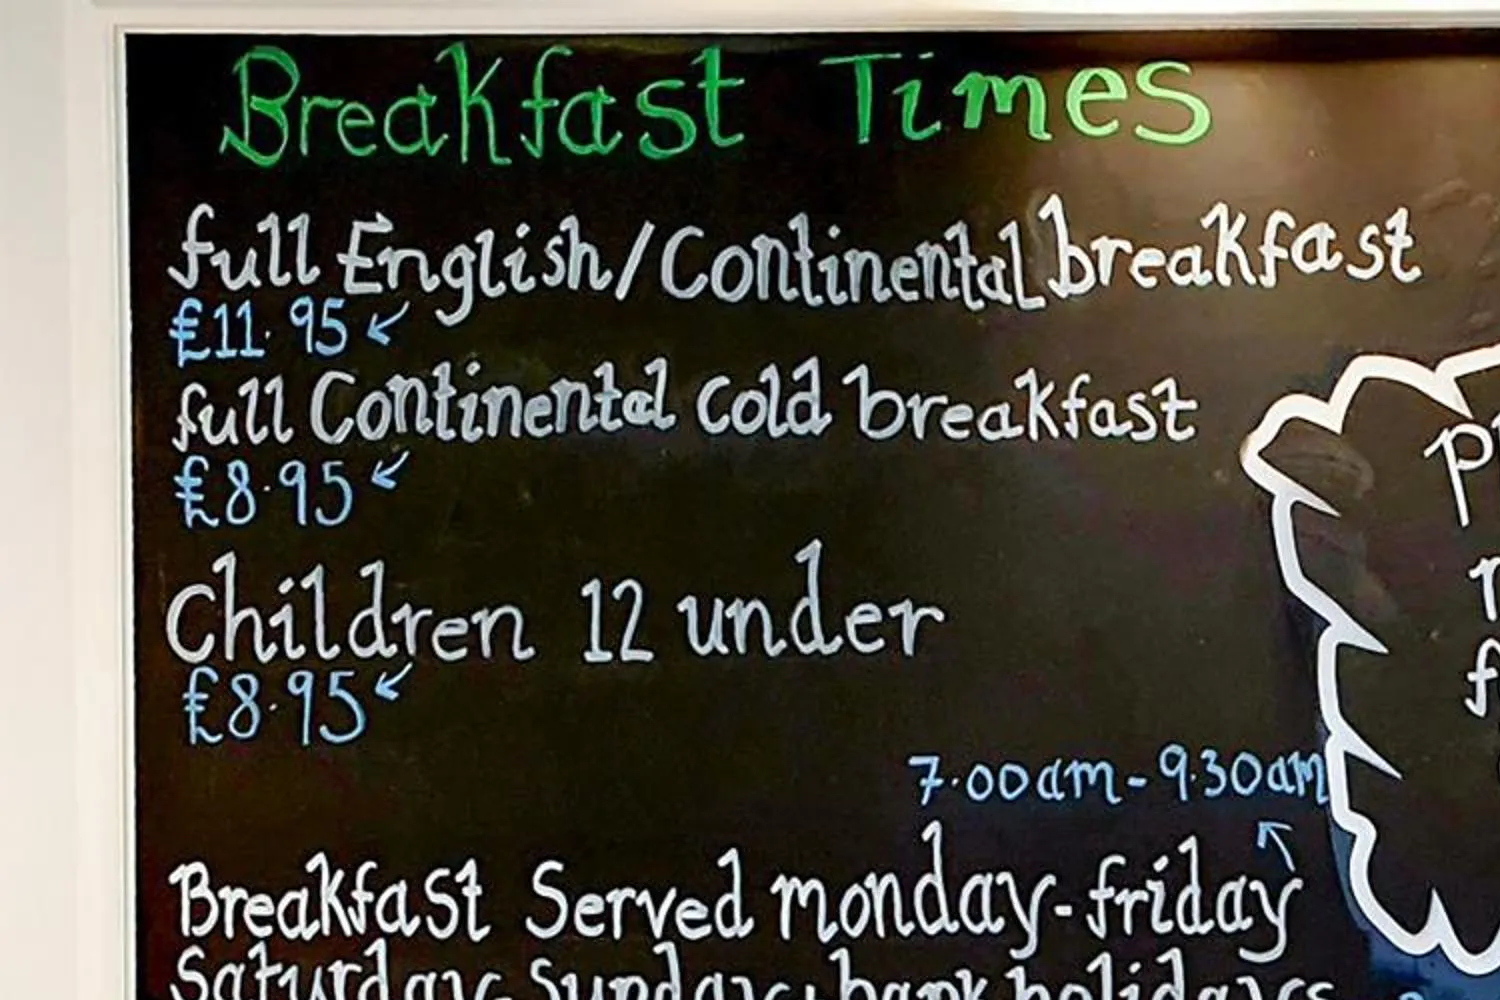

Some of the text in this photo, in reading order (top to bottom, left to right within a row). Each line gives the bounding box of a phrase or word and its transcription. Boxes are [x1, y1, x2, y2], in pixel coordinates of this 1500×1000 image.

[220, 43, 1212, 167] Breakfast Times
[168, 203, 320, 291] full
[1037, 192, 1422, 299] breakfast
[172, 376, 294, 453] full
[310, 357, 677, 445] Continental
[842, 363, 1198, 442] breakfast
[165, 538, 945, 664] Children 12 under
[168, 851, 491, 943] Breakfast
